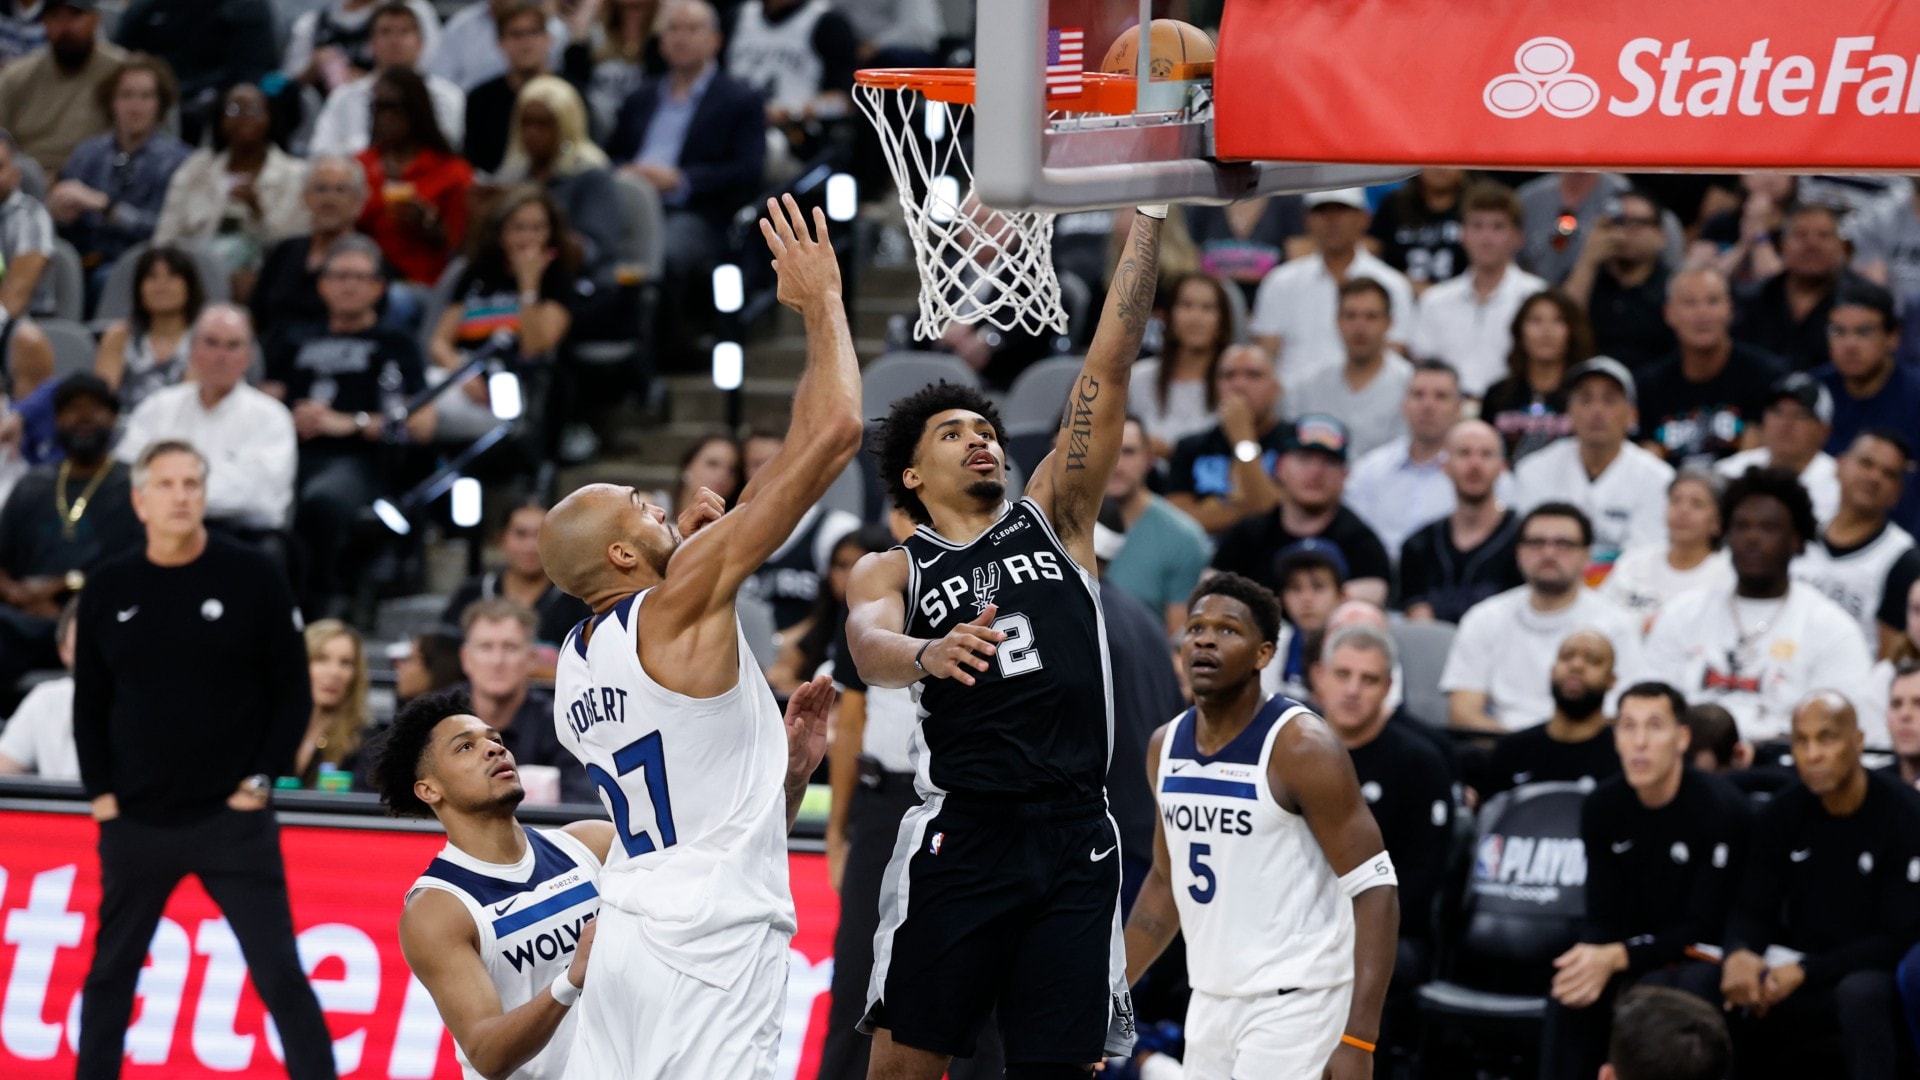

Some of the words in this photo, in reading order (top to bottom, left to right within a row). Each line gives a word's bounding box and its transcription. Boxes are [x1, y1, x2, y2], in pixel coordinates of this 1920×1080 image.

[1066, 375, 1099, 472] WAWG
[994, 520, 1025, 541] LEDGER
[991, 611, 1044, 679] 2
[585, 729, 678, 859] 27
[1162, 803, 1253, 836] WOLVES
[1187, 841, 1217, 905] 5
[1374, 860, 1390, 876] 5
[501, 908, 601, 975] WOLV
